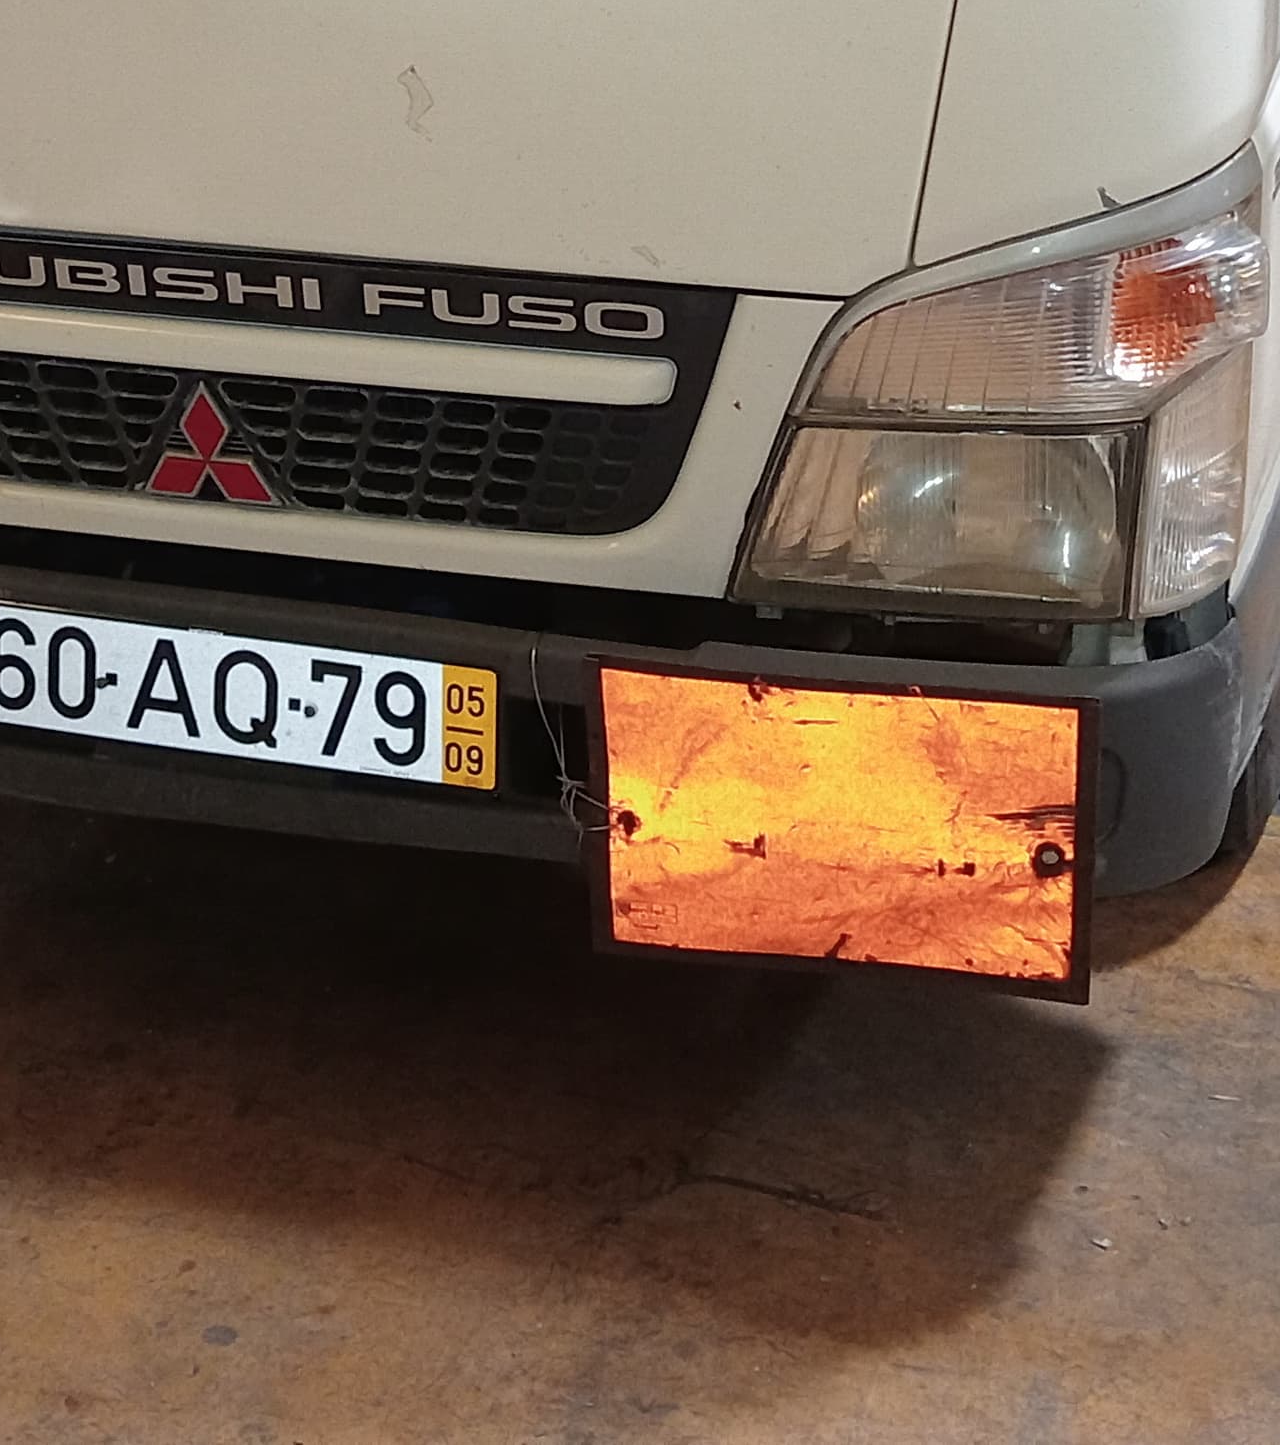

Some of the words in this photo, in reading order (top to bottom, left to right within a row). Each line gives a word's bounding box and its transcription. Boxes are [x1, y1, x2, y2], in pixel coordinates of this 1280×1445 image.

[363, 282, 666, 341] FUSO
[446, 683, 486, 718] 05
[444, 741, 484, 776] 09
